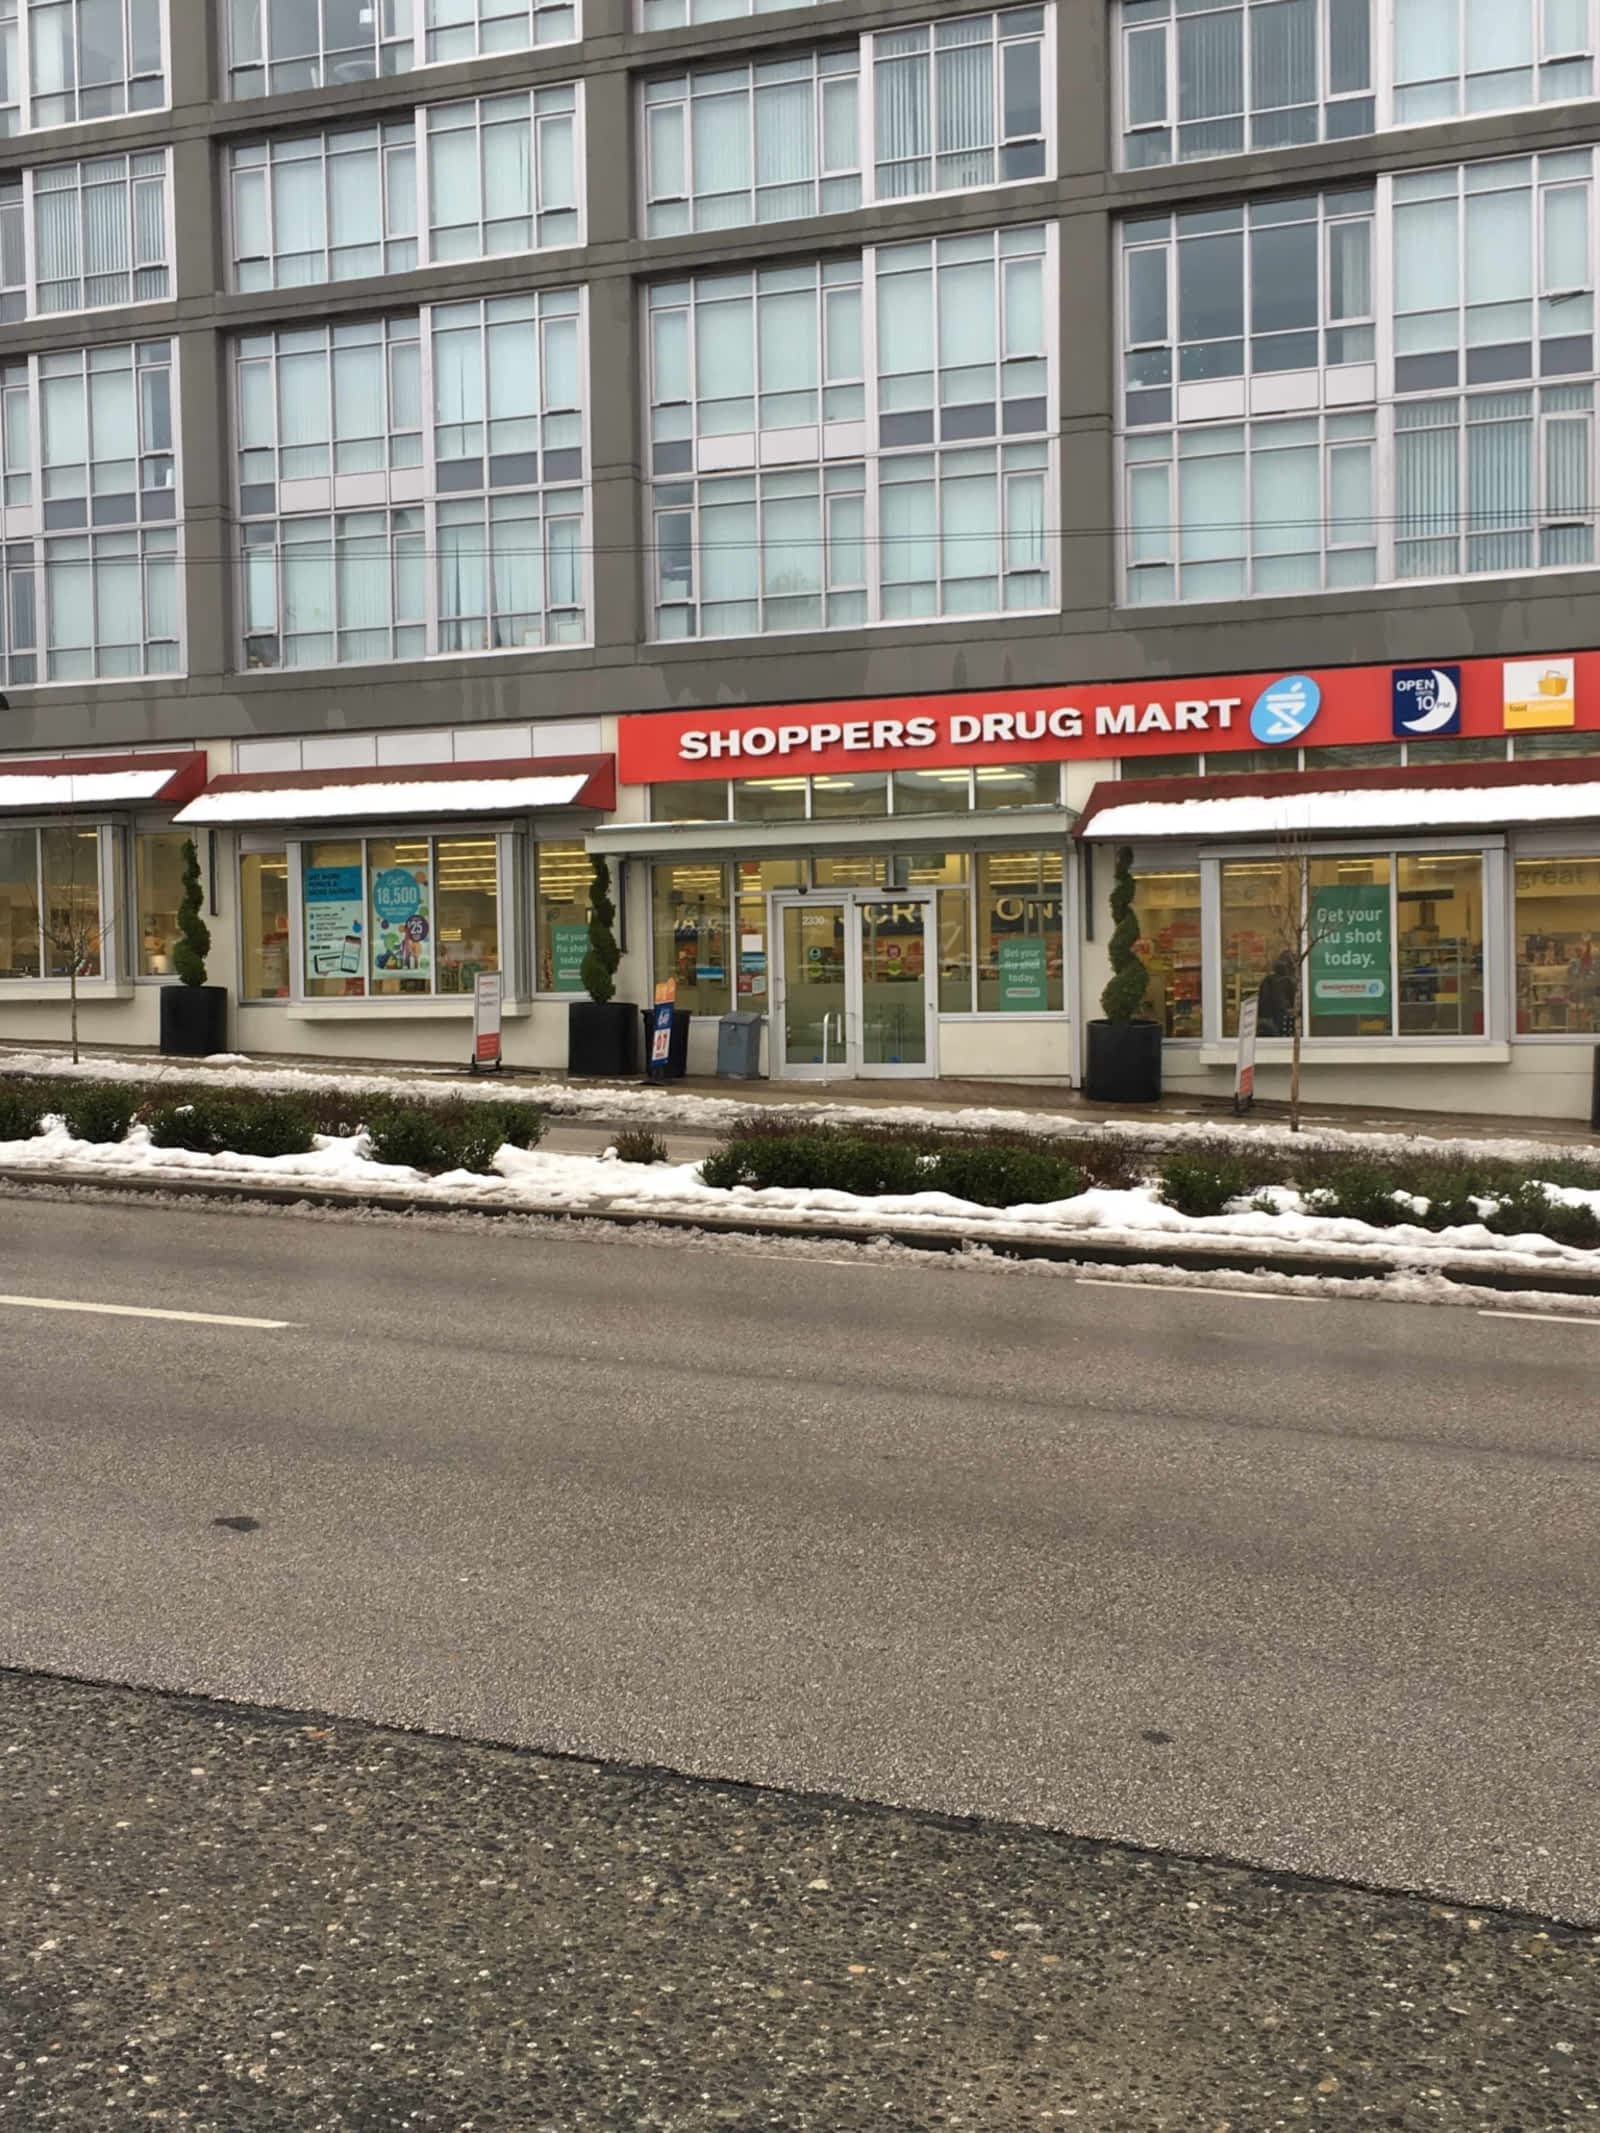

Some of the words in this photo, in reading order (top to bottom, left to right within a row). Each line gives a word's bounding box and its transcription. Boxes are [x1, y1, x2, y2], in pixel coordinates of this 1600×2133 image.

[1396, 679, 1435, 692] OPEN
[1416, 695, 1435, 712] 10
[679, 717, 937, 759] SHOPPERS
[950, 708, 1083, 744] DRUG
[1095, 698, 1241, 736] MART
[377, 886, 417, 906] 18,500
[1317, 908, 1344, 923] Get
[1346, 908, 1383, 925] your
[1344, 927, 1383, 944] shot
[1324, 950, 1376, 968] today.
